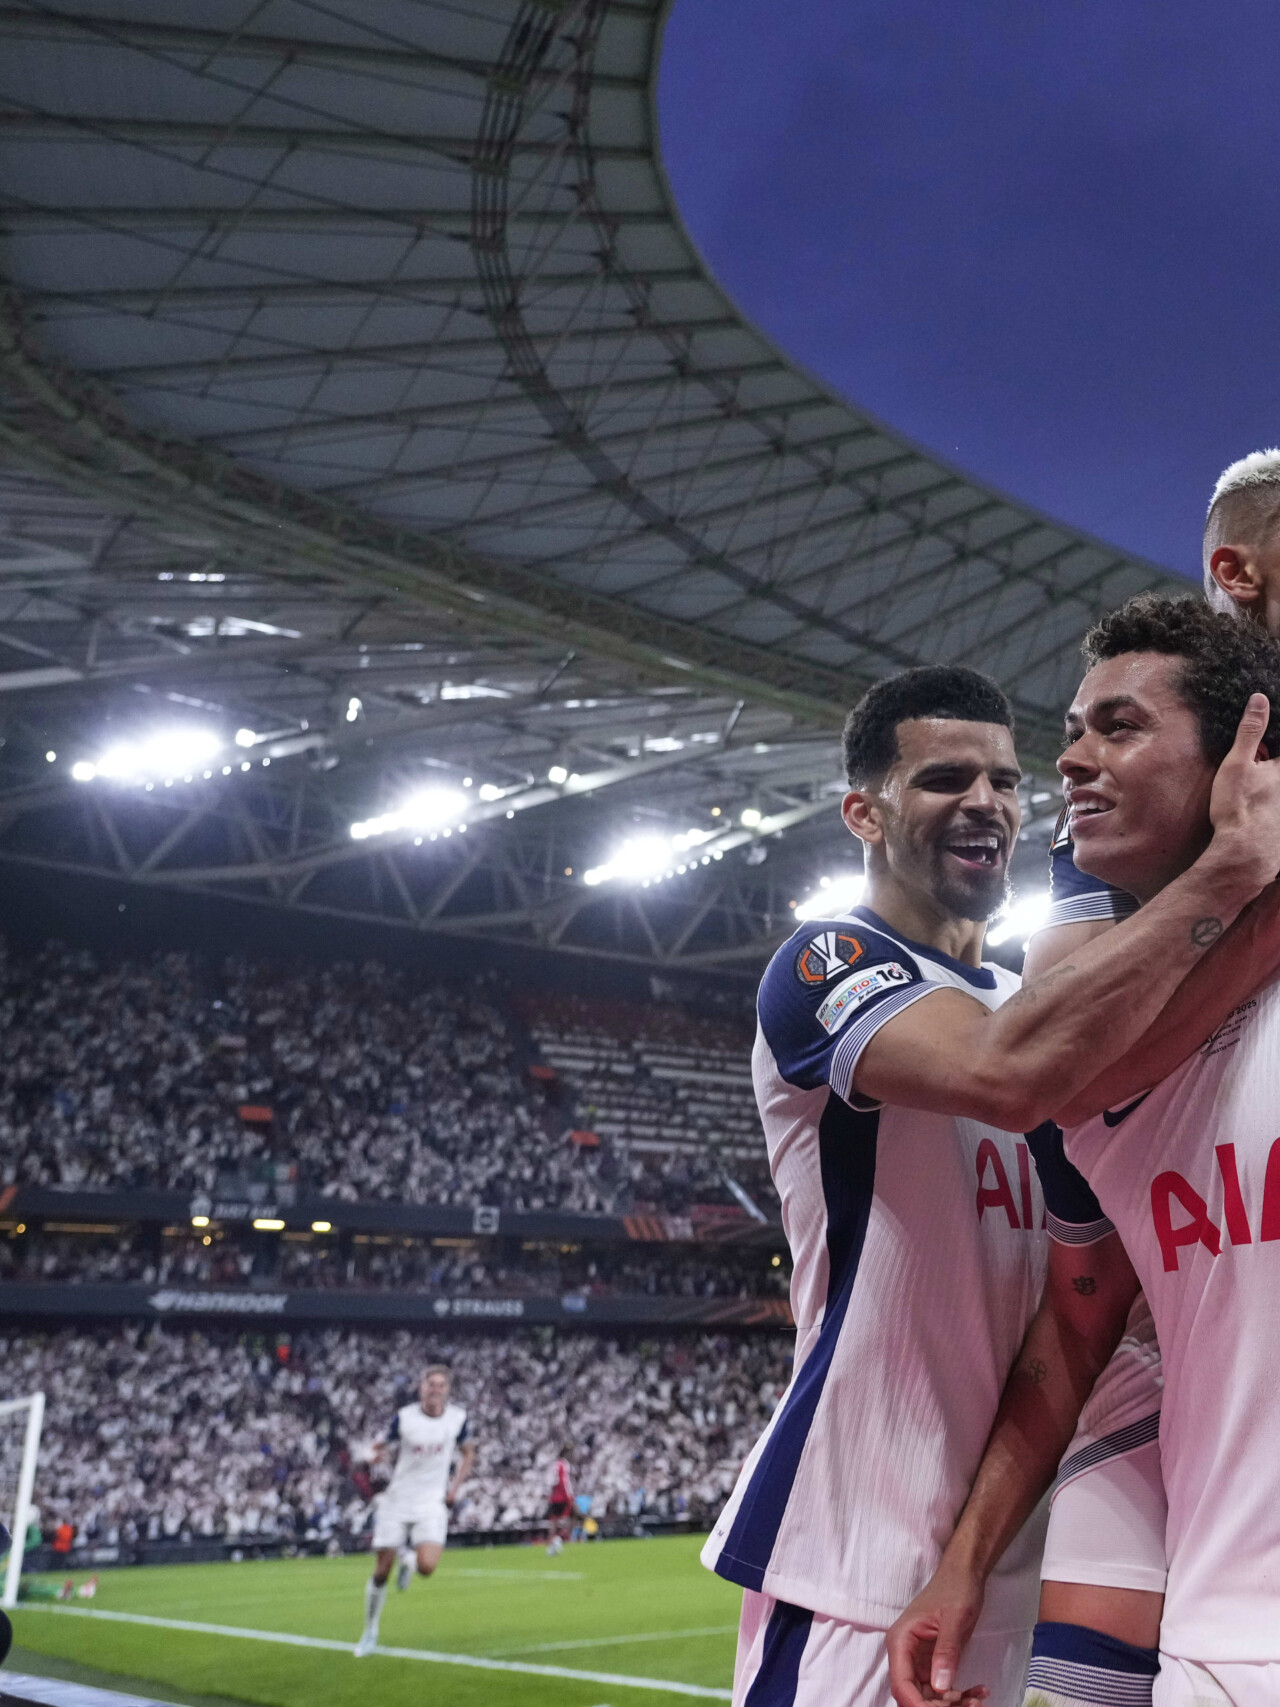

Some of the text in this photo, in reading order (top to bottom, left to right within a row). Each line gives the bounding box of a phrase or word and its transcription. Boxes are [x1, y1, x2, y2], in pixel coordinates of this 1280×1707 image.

[824, 976, 878, 1028] FOUNDATION
[1236, 999, 1257, 1014] 2025
[976, 1138, 1046, 1230] AI
[452, 1300, 524, 1316] STRAUSS
